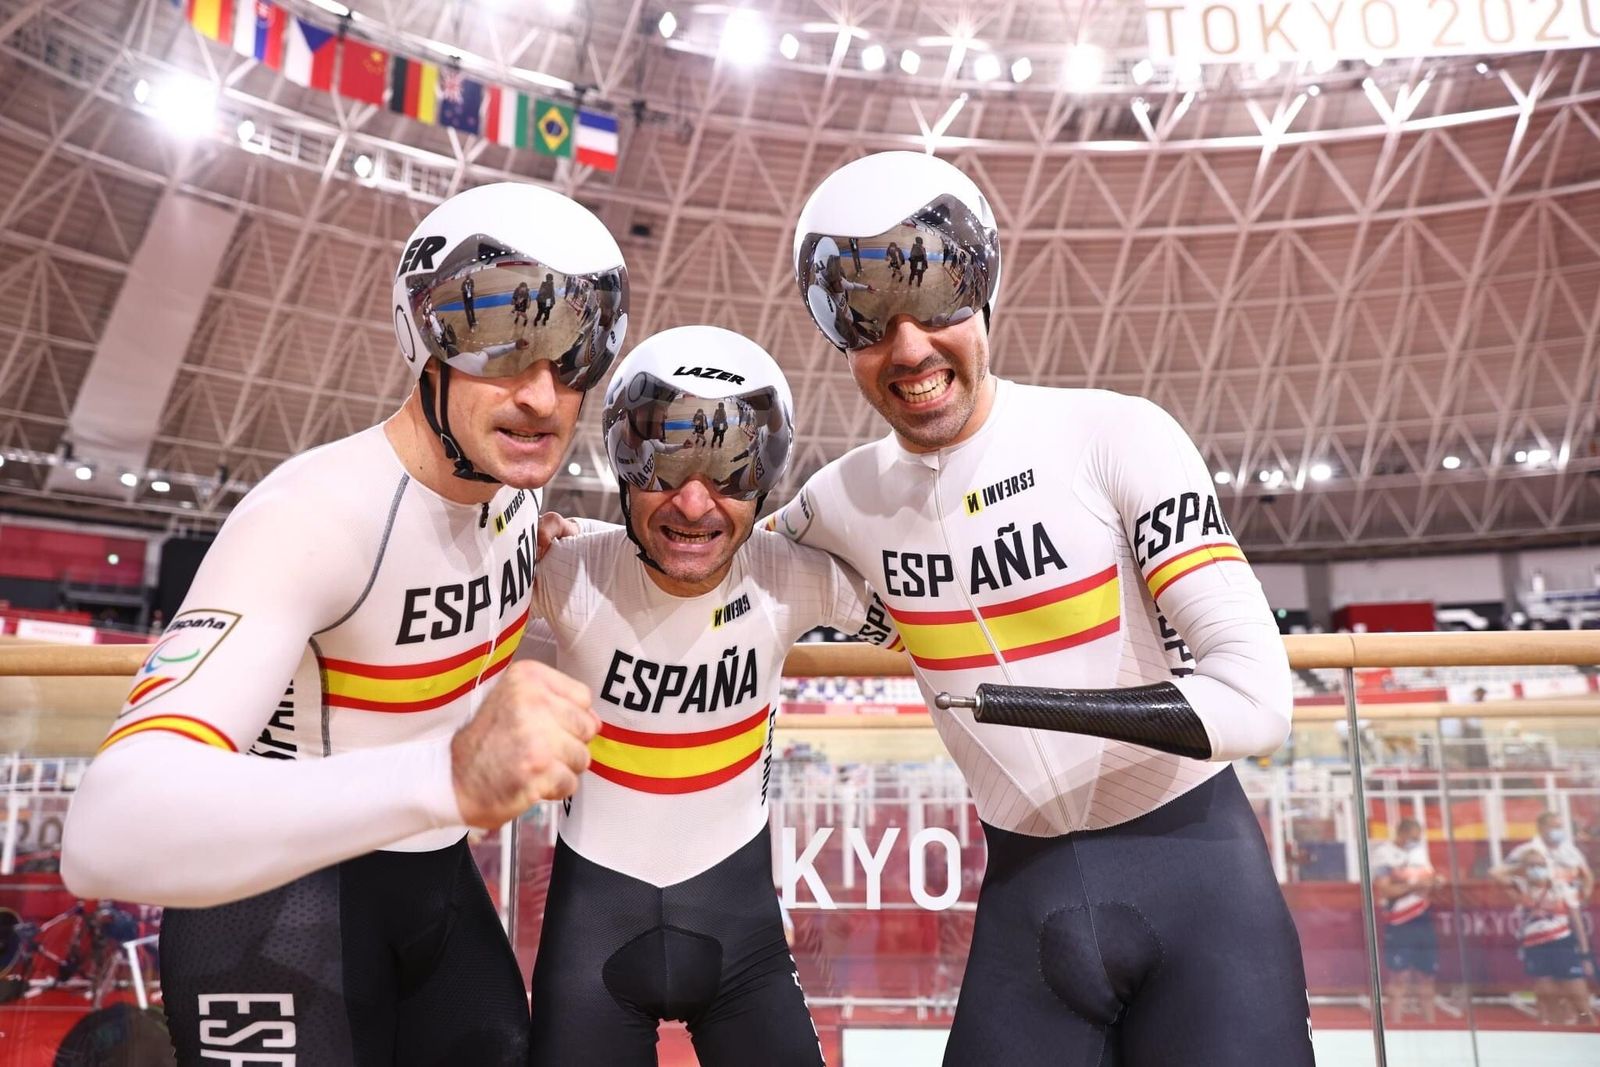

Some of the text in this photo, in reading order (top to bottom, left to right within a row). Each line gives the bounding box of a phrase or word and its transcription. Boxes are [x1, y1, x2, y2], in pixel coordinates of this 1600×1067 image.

[1147, 0, 1400, 56] TOKYO
[673, 366, 746, 385] LAZER
[1134, 492, 1230, 569] ESPA
[600, 645, 758, 714] ESPAÑA
